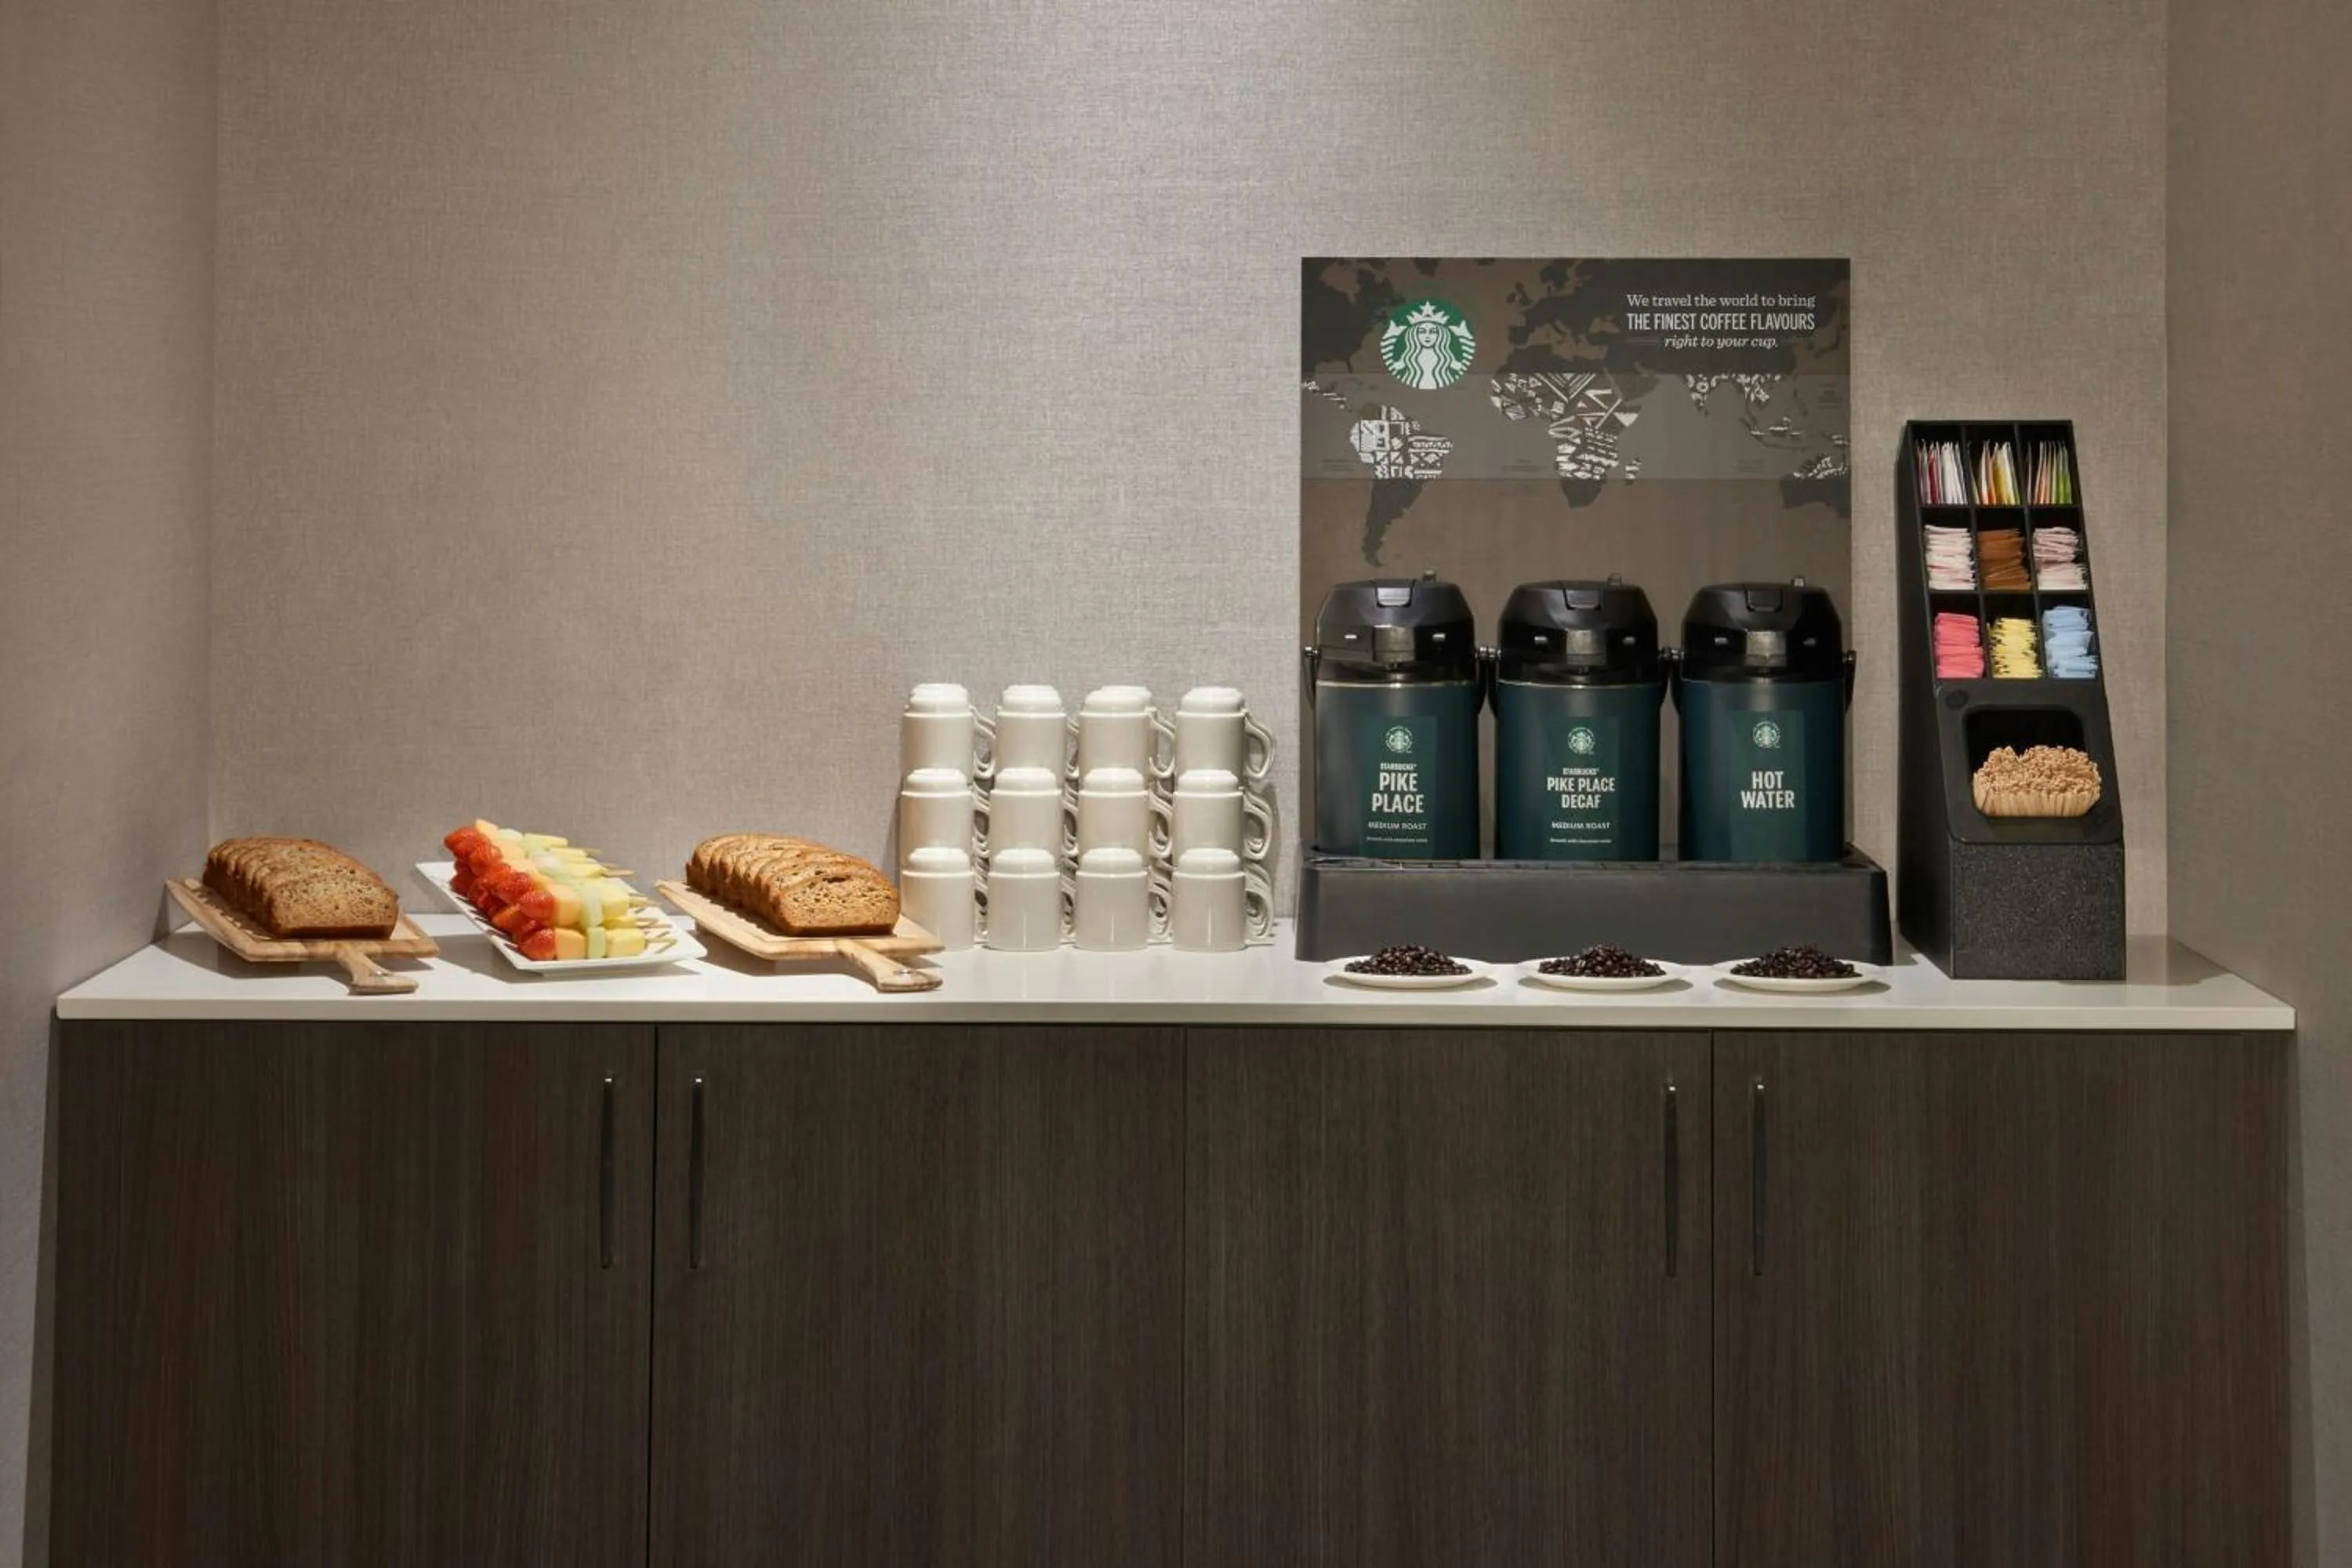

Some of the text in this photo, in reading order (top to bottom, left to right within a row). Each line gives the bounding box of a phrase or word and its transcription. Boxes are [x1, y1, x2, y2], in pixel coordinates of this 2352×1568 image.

[1627, 295, 1816, 310] We travel the world to bring
[1627, 314, 1816, 330] THE FINEST COFFEE FLAVOURS
[1664, 335, 1779, 350] right to your cup.
[1379, 772, 1417, 792] PIKE
[1547, 777, 1616, 792] PIKE PLACE
[1751, 771, 1784, 789] HOT
[1372, 793, 1425, 813] PLACE
[1561, 794, 1602, 808] DECAF
[1740, 790, 1795, 808] WATER
[1367, 821, 1400, 829] MEDIUM
[1552, 821, 1584, 829] MEDIUM
